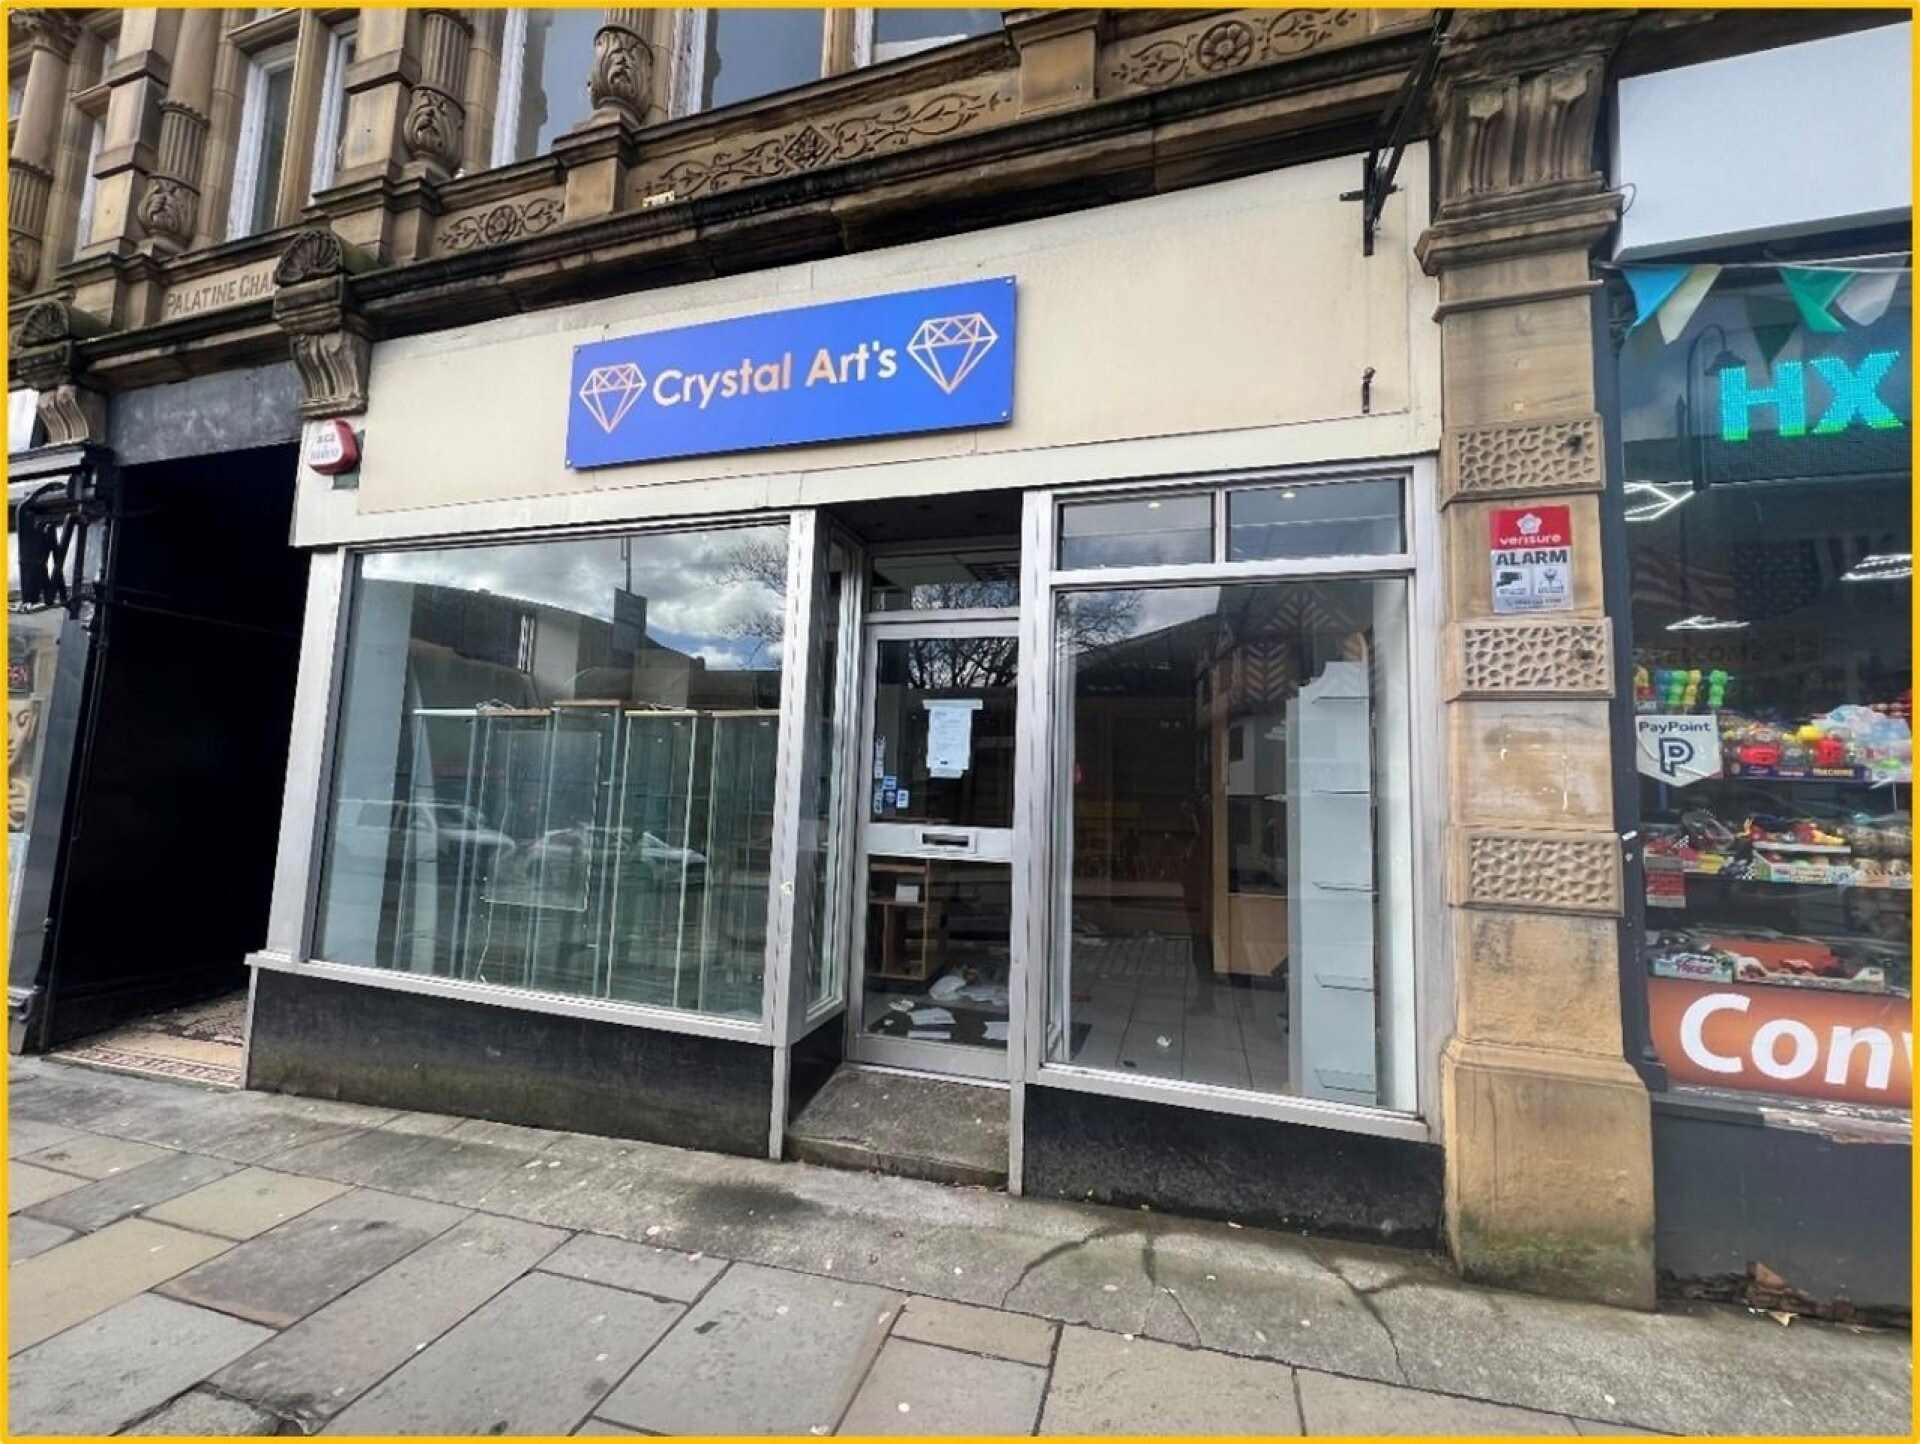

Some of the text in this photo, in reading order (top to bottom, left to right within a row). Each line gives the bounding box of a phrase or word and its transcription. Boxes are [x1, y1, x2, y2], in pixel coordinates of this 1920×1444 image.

[167, 280, 238, 315] PALATINE
[652, 340, 898, 410] Crystal Art's
[1719, 351, 1904, 441] HX
[1499, 534, 1562, 546] verisure
[1496, 550, 1568, 566] ALARM
[1638, 721, 1712, 734] PayPoint
[1679, 992, 1912, 1090] Con
